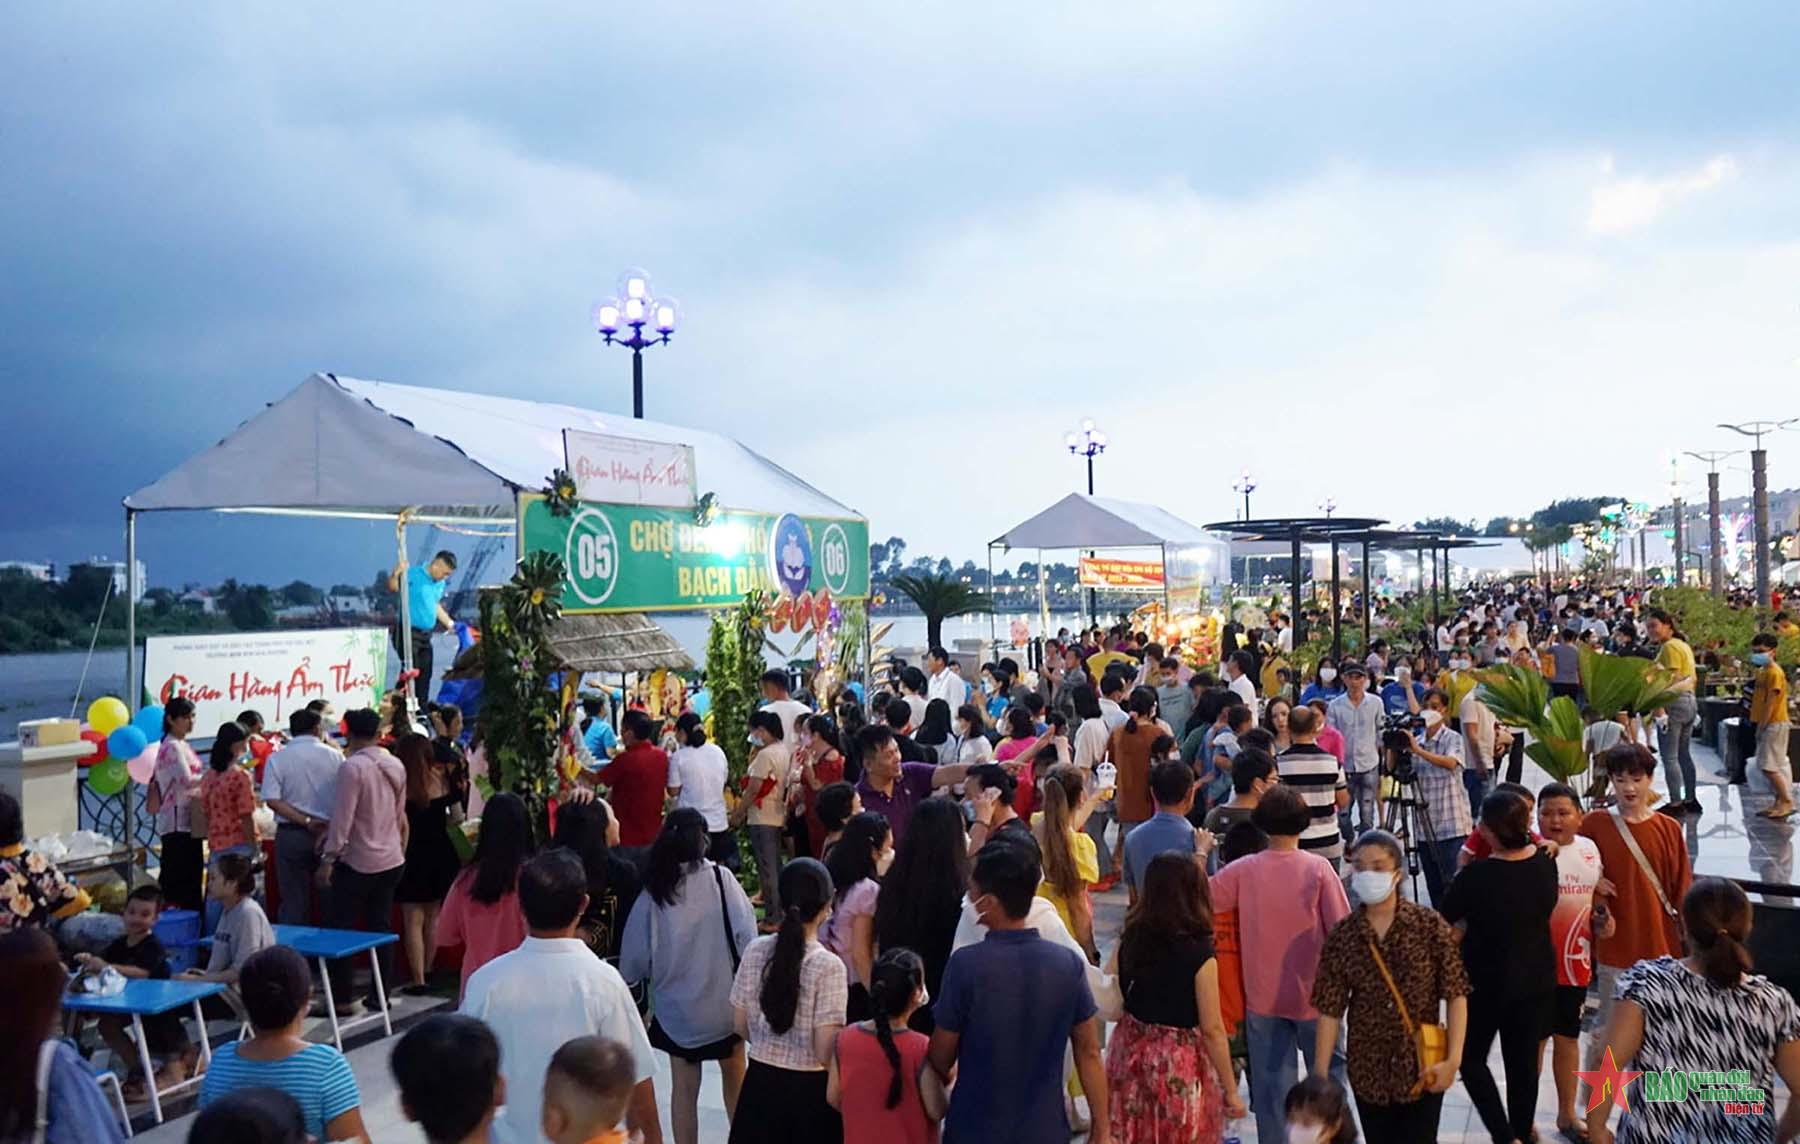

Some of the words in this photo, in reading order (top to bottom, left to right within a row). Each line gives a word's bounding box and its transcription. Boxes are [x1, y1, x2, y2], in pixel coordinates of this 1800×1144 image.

[578, 533, 611, 579] 05
[629, 519, 674, 559] CHỢ
[826, 541, 845, 576] 06
[678, 565, 731, 603] BẠCH
[735, 556, 778, 597] ĐẰN
[160, 673, 223, 706] Gian
[229, 671, 281, 722] Hàng
[287, 655, 324, 698] Ẩm
[329, 658, 376, 693] Thực
